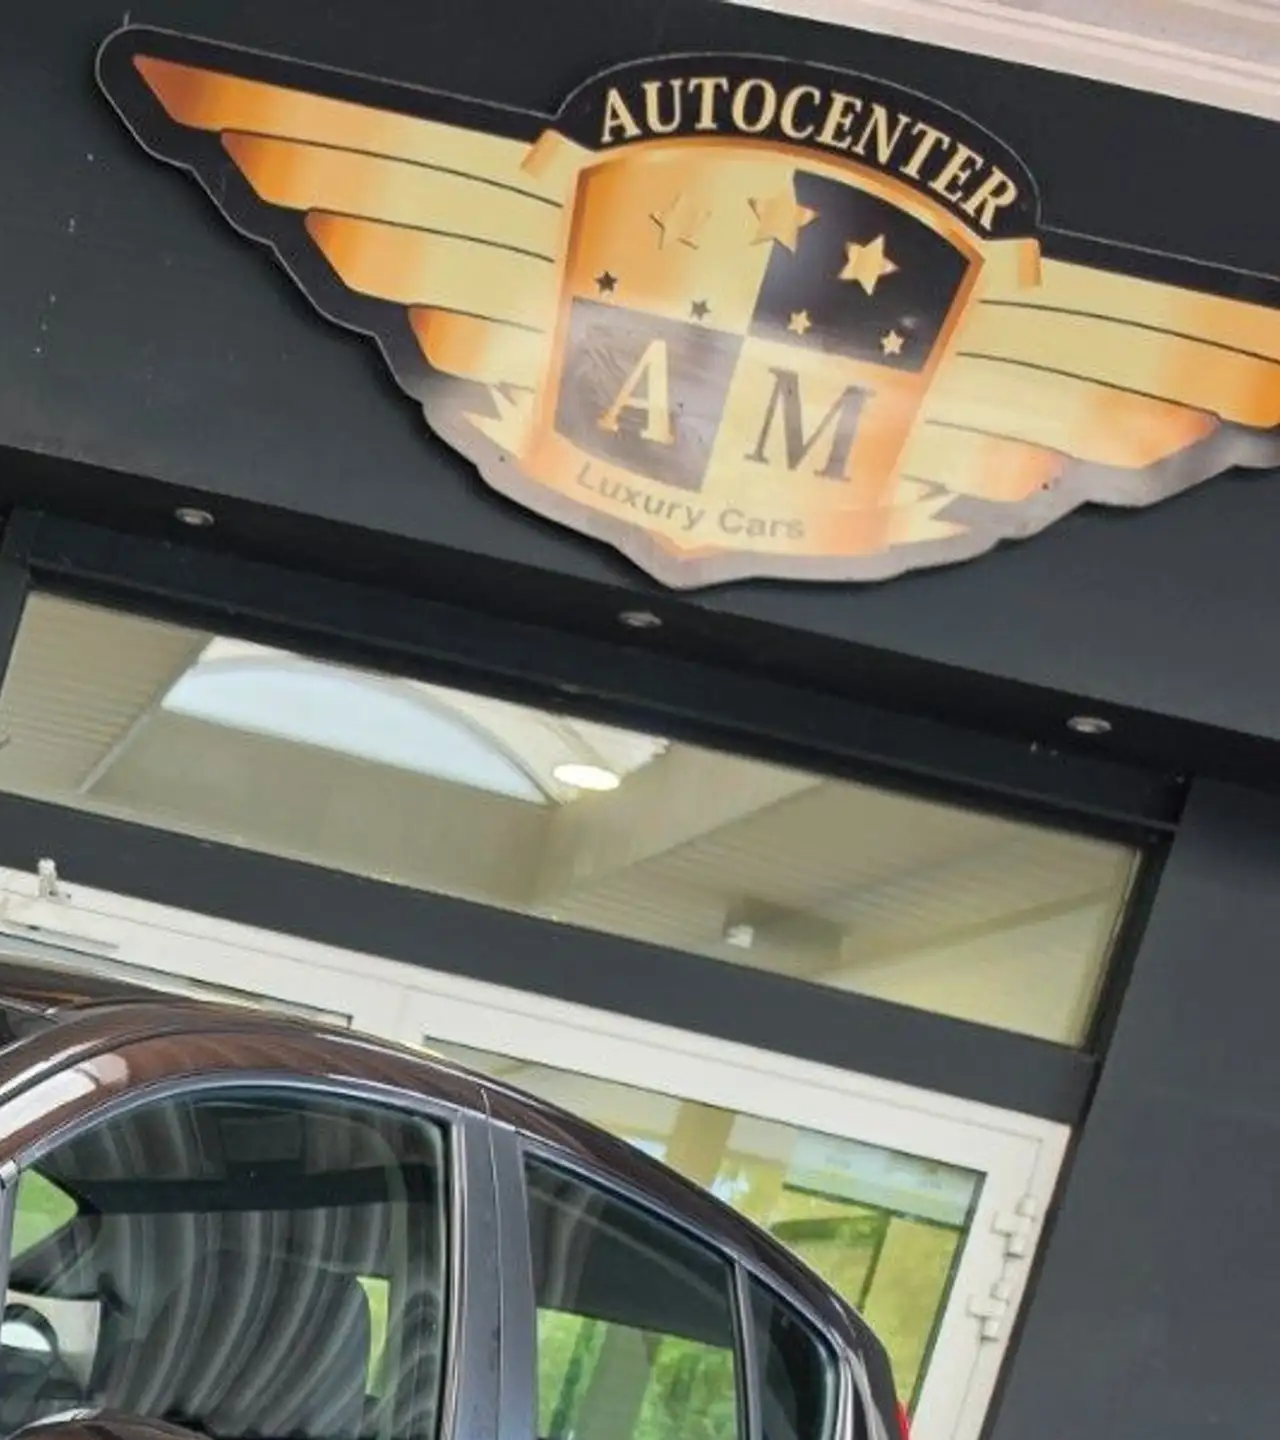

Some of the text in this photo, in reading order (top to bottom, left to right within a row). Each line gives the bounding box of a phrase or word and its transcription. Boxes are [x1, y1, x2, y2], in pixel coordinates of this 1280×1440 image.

[599, 75, 1020, 232] AUTOCENTER
[596, 339, 877, 483] A M
[574, 459, 807, 540] Luxury Cars
